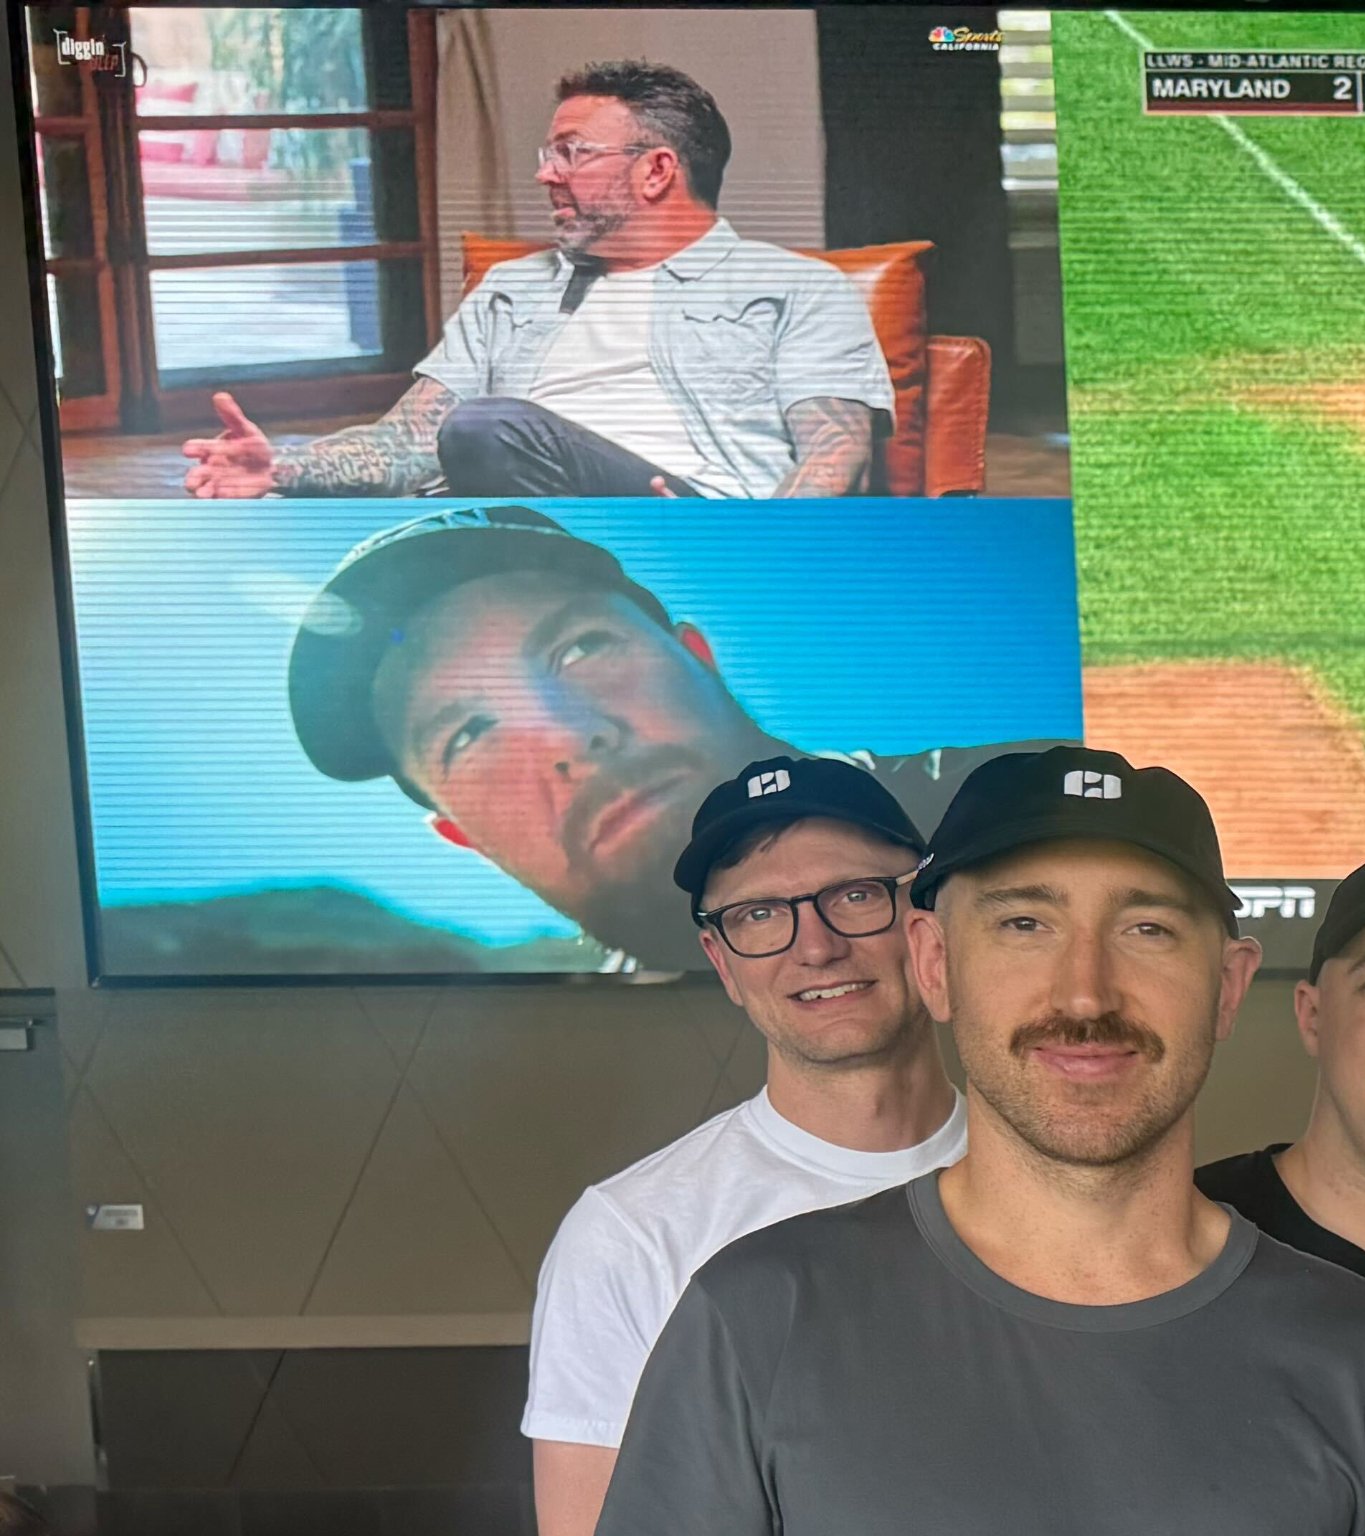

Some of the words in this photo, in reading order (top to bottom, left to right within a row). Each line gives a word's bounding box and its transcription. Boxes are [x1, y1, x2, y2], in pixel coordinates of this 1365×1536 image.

[932, 43, 999, 51] CALIFORNIA
[1146, 54, 1194, 68] LLWS
[1207, 54, 1329, 69] MID-ATLANTIC
[1152, 77, 1291, 99] MARYLAND
[1332, 75, 1353, 101] 2
[1228, 886, 1316, 918] SPN
